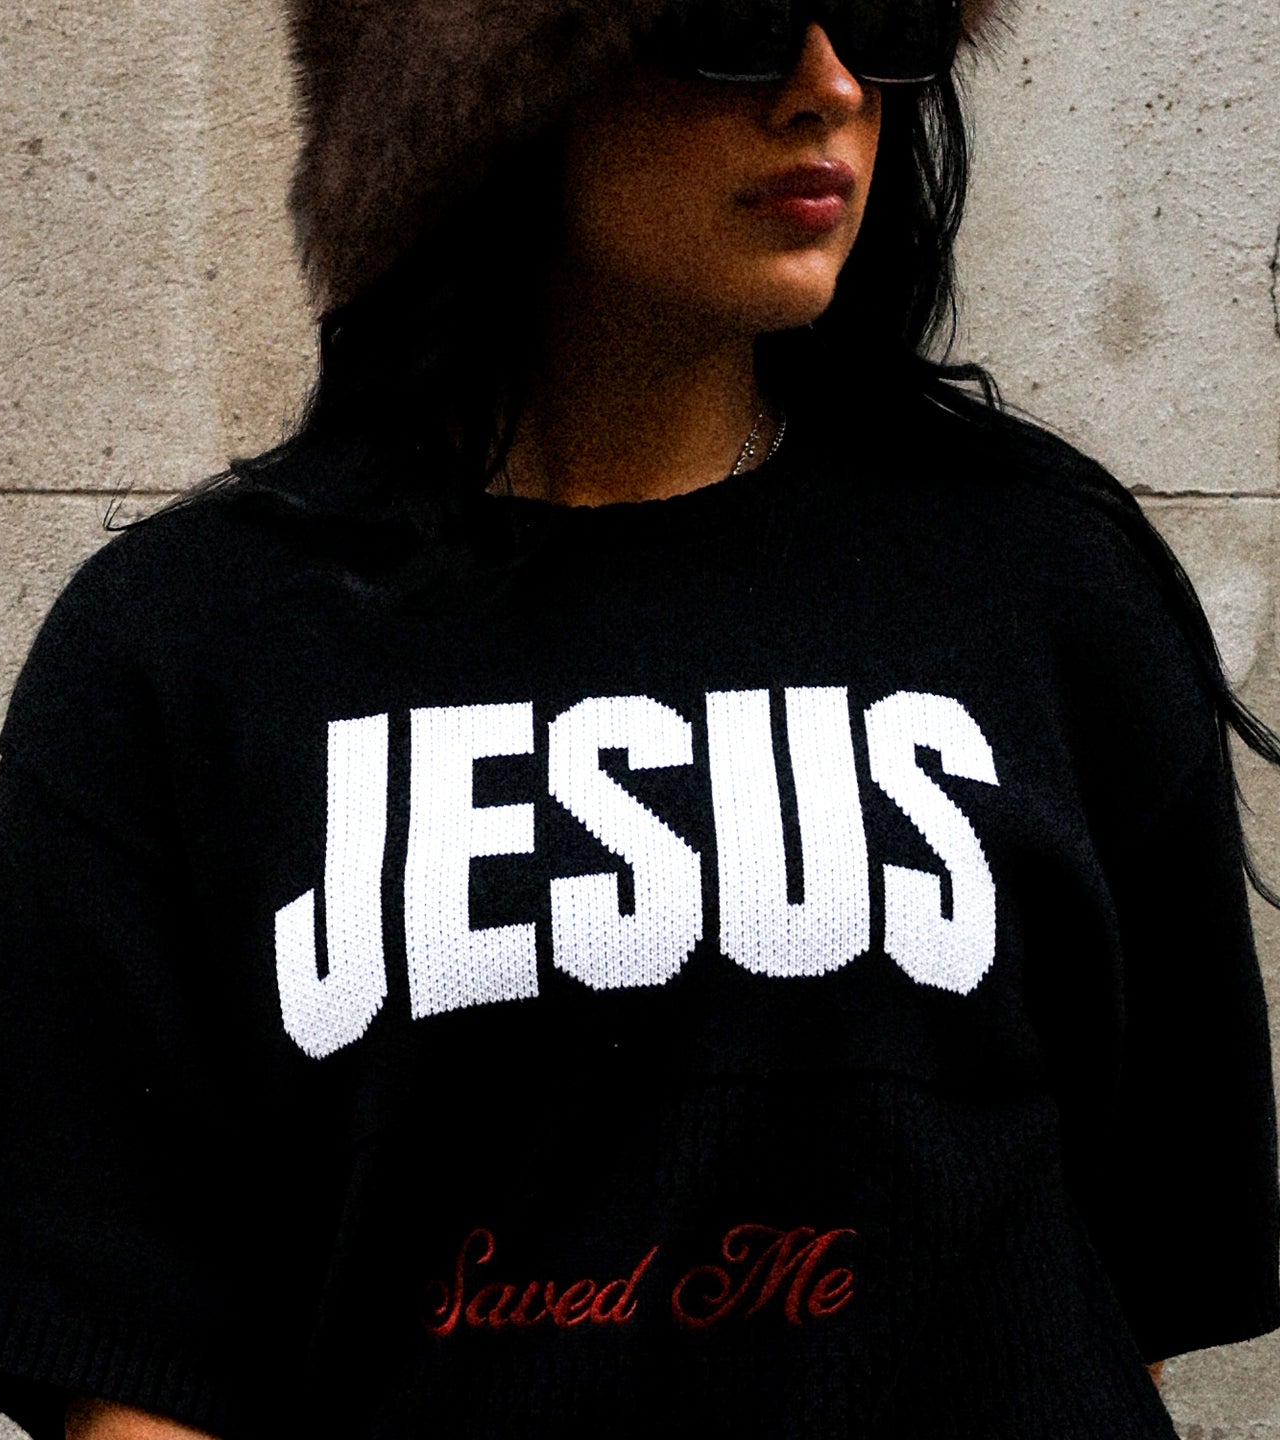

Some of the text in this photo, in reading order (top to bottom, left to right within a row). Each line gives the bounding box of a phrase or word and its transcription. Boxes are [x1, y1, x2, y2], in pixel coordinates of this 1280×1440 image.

[274, 685, 1001, 1060] JESUS
[423, 1223, 858, 1337] Saved Me
